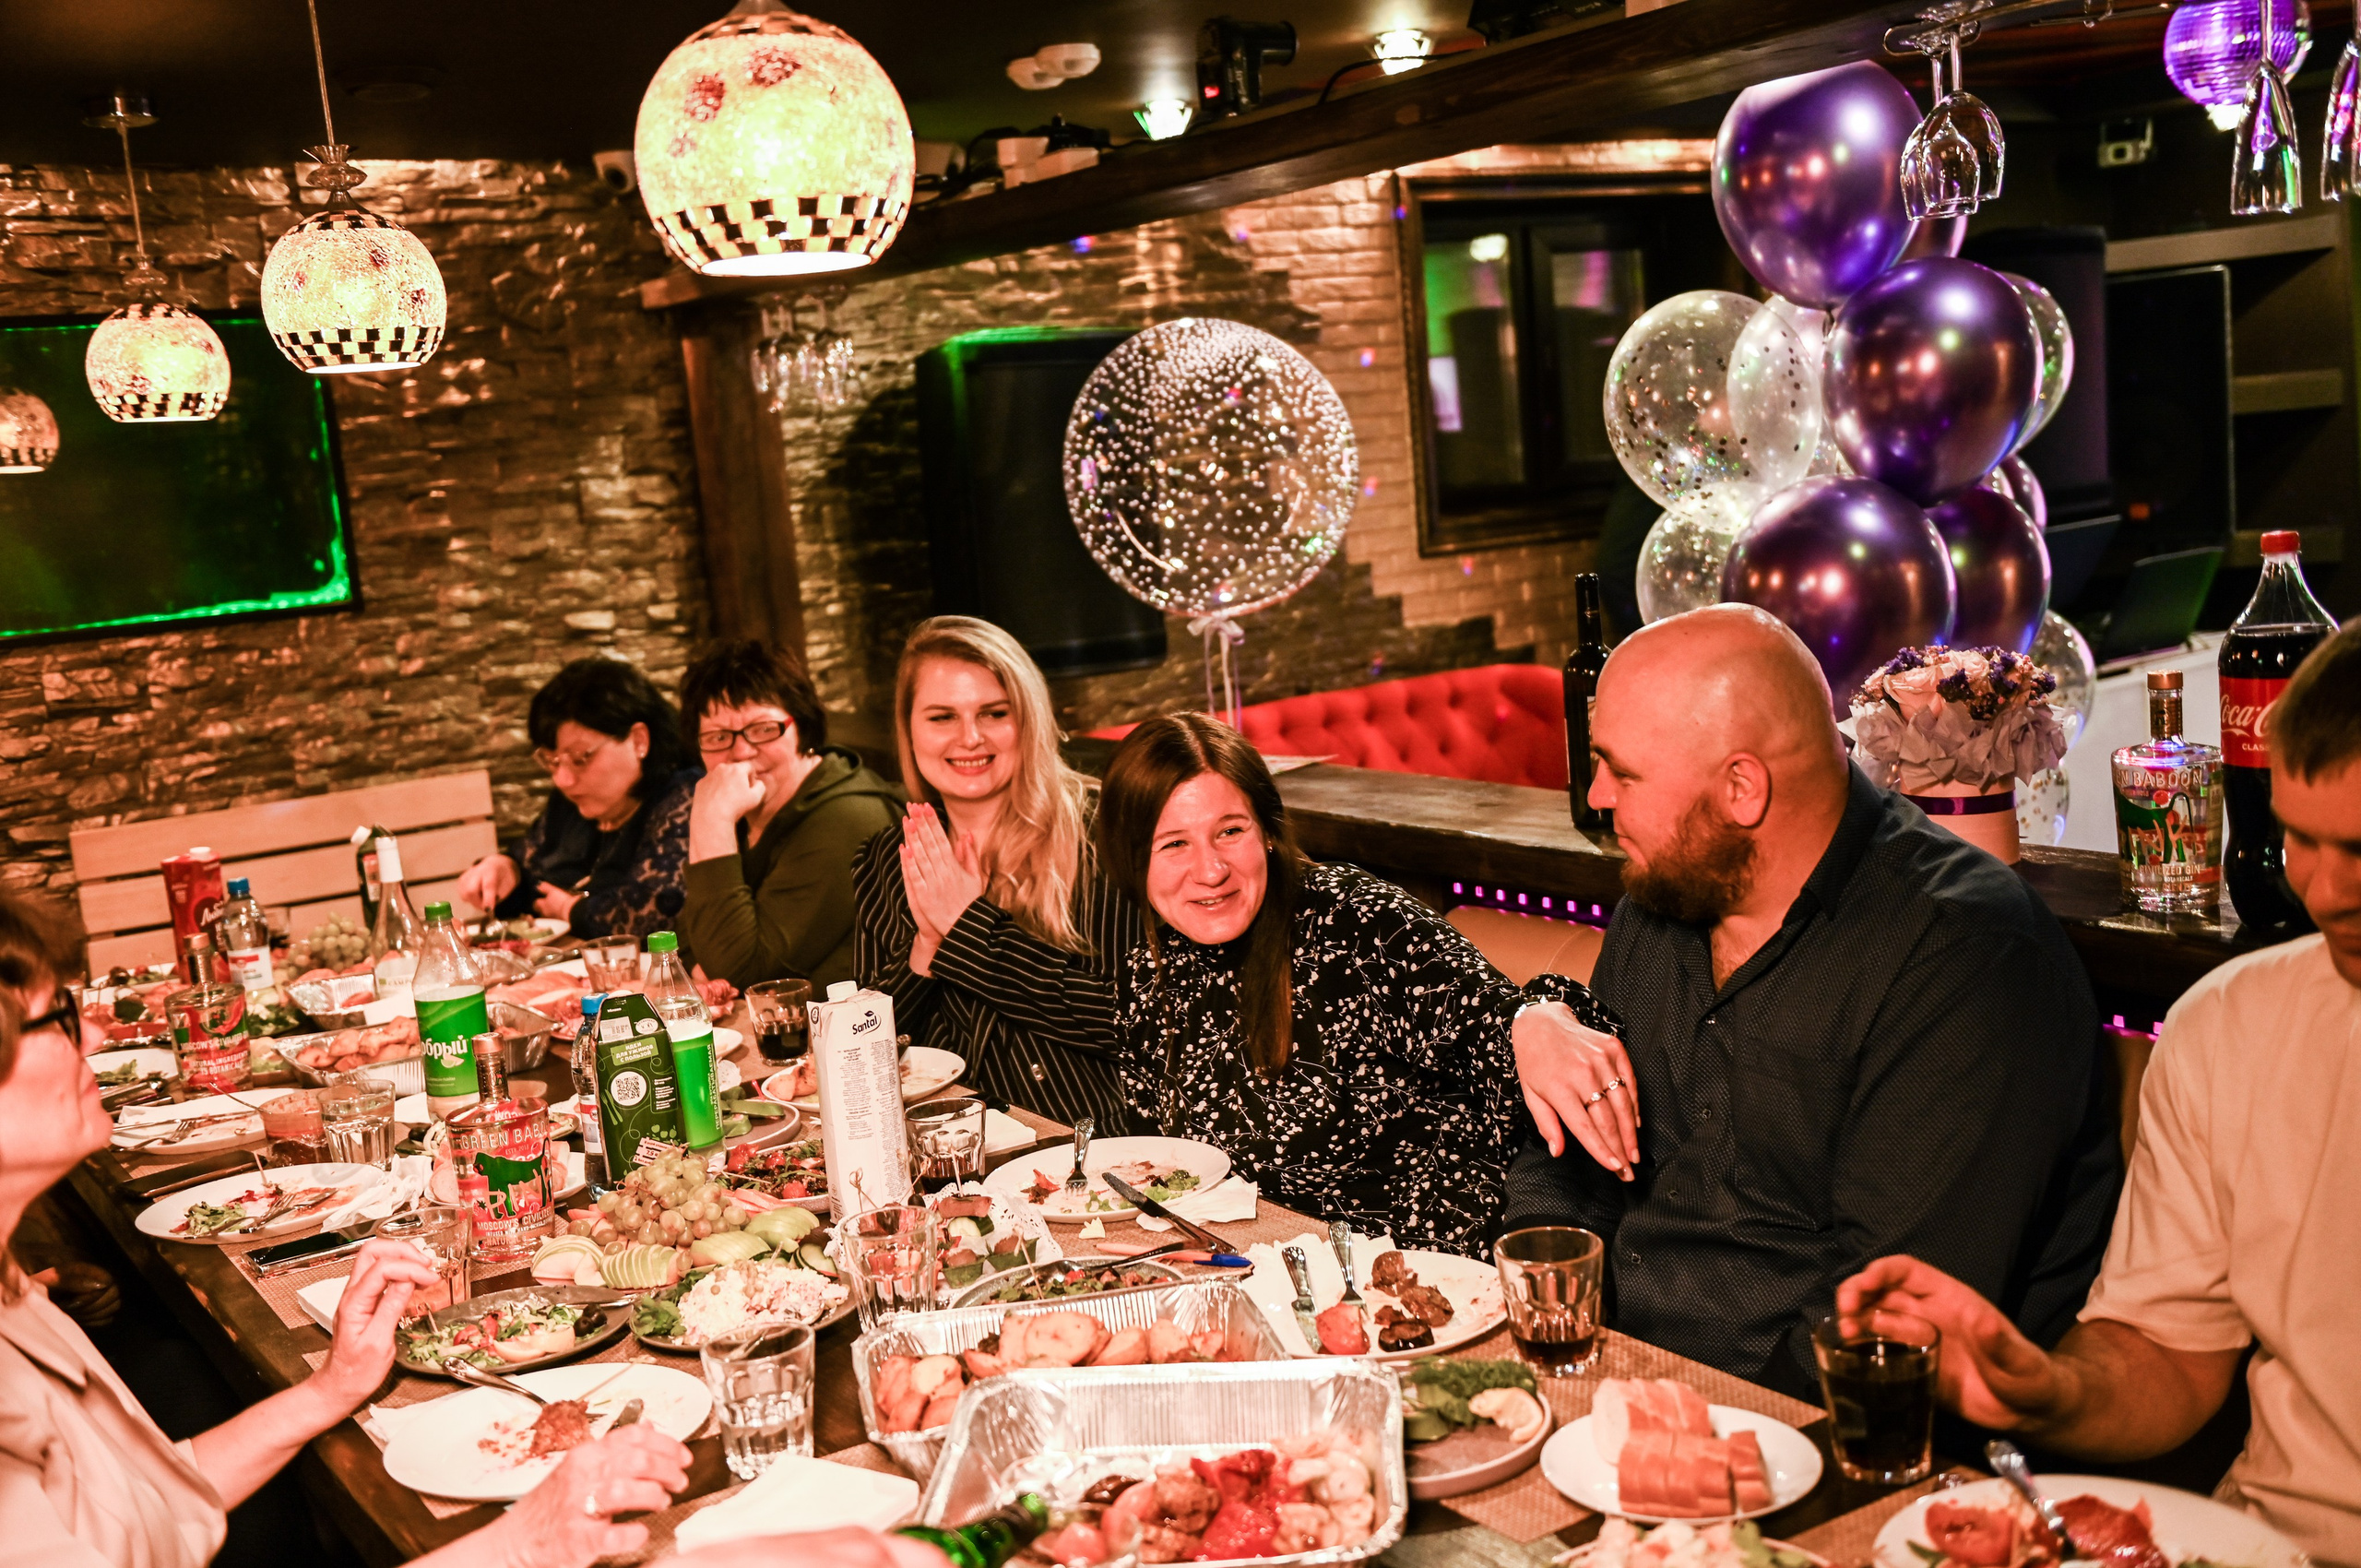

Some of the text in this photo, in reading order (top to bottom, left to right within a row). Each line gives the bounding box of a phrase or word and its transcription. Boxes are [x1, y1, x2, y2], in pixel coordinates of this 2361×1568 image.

[2220, 694, 2278, 737] Coca-C
[2241, 742, 2270, 752] CLAS
[2133, 767, 2202, 788] BABOON
[2186, 865, 2201, 874] GIN
[852, 1016, 878, 1035] Santal
[421, 1035, 468, 1059] обрый
[625, 1041, 642, 1051] ИДЕИ
[628, 1044, 654, 1055] УЖИНОВ
[624, 1050, 652, 1062] ПОЛЬЗОЙ
[461, 1121, 546, 1149] GREEN BABO
[477, 1206, 552, 1230] MOSCOW'S CIVILIZE
